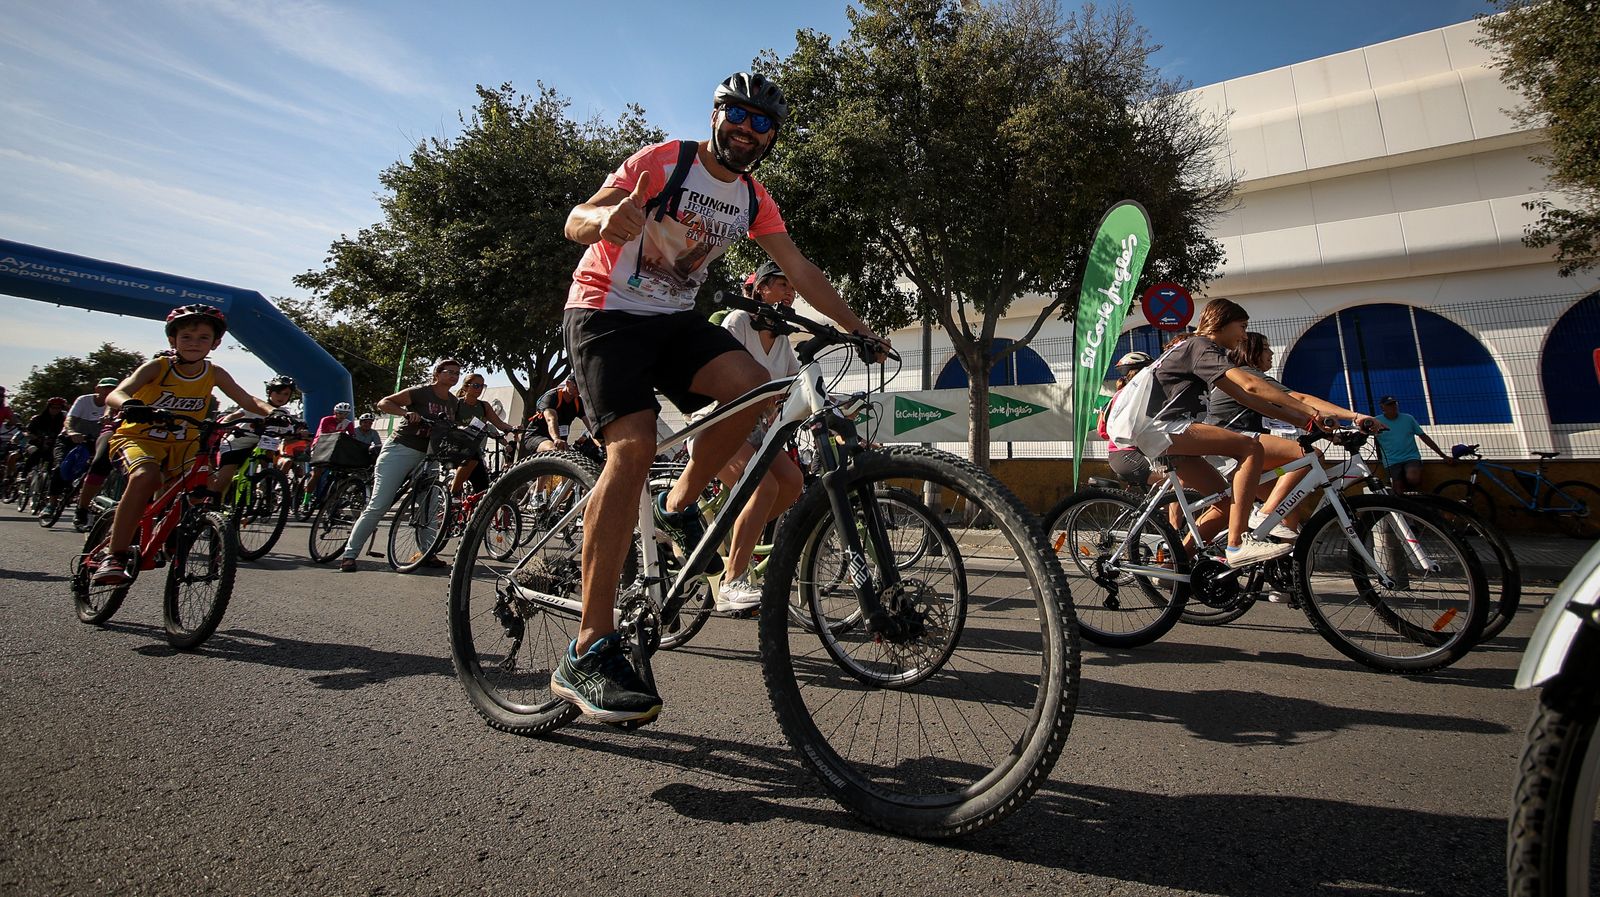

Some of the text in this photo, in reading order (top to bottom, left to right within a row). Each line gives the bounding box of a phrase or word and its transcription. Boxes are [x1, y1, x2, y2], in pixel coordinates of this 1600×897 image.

[684, 201, 717, 219] JEREZ
[685, 228, 722, 248] 5K 10K
[0, 264, 71, 283] Deportes
[1, 257, 225, 303] Ayuntamiento de Jerez
[1087, 302, 1115, 348] Corte
[1081, 346, 1097, 369] El
[895, 409, 903, 419] El
[902, 409, 918, 419] Corte
